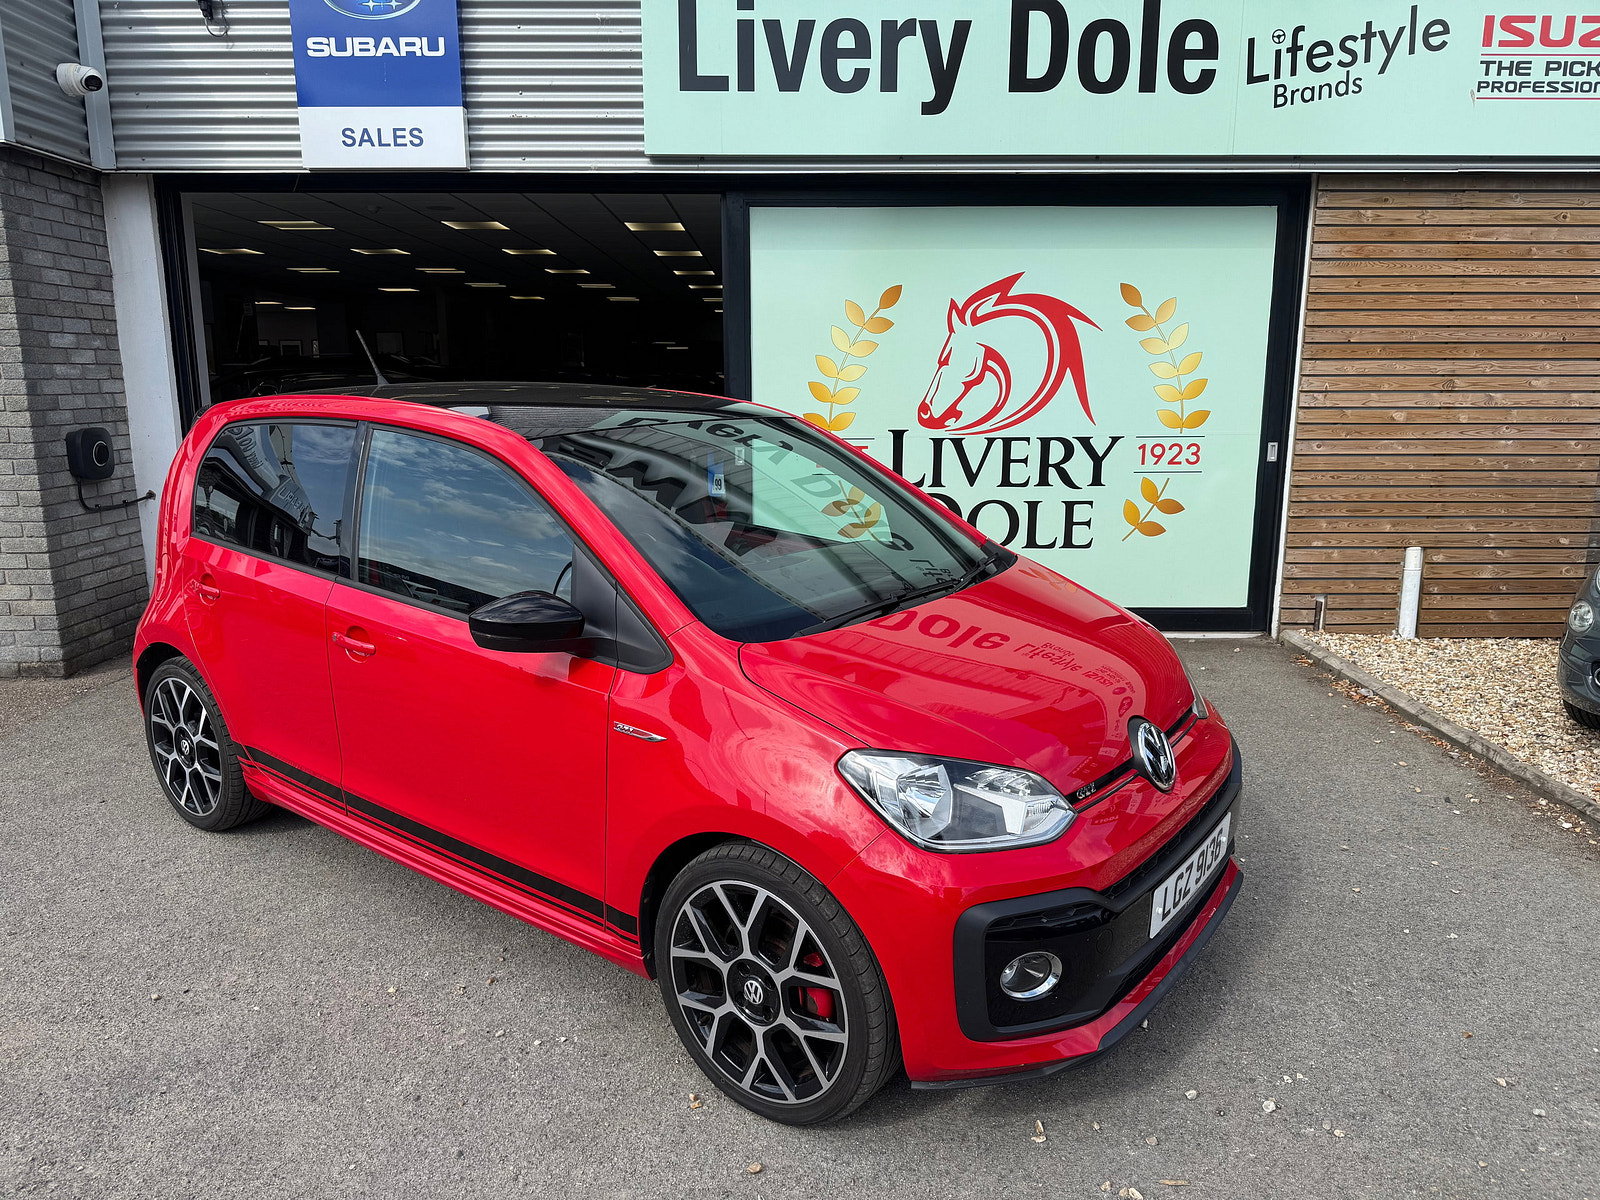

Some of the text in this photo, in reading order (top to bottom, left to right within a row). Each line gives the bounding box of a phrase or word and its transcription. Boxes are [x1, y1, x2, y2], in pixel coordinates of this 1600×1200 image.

[306, 36, 446, 58] SUBARU
[678, 0, 1220, 116] Livery Dole
[1246, 4, 1451, 85] Lifestyle
[1479, 60, 1600, 77] THE PICK
[1273, 69, 1364, 109] Brands
[341, 126, 425, 149] SALES
[887, 429, 1126, 490] LIVERY
[1137, 442, 1202, 466] 1923
[1161, 860, 1195, 922] LGZ
